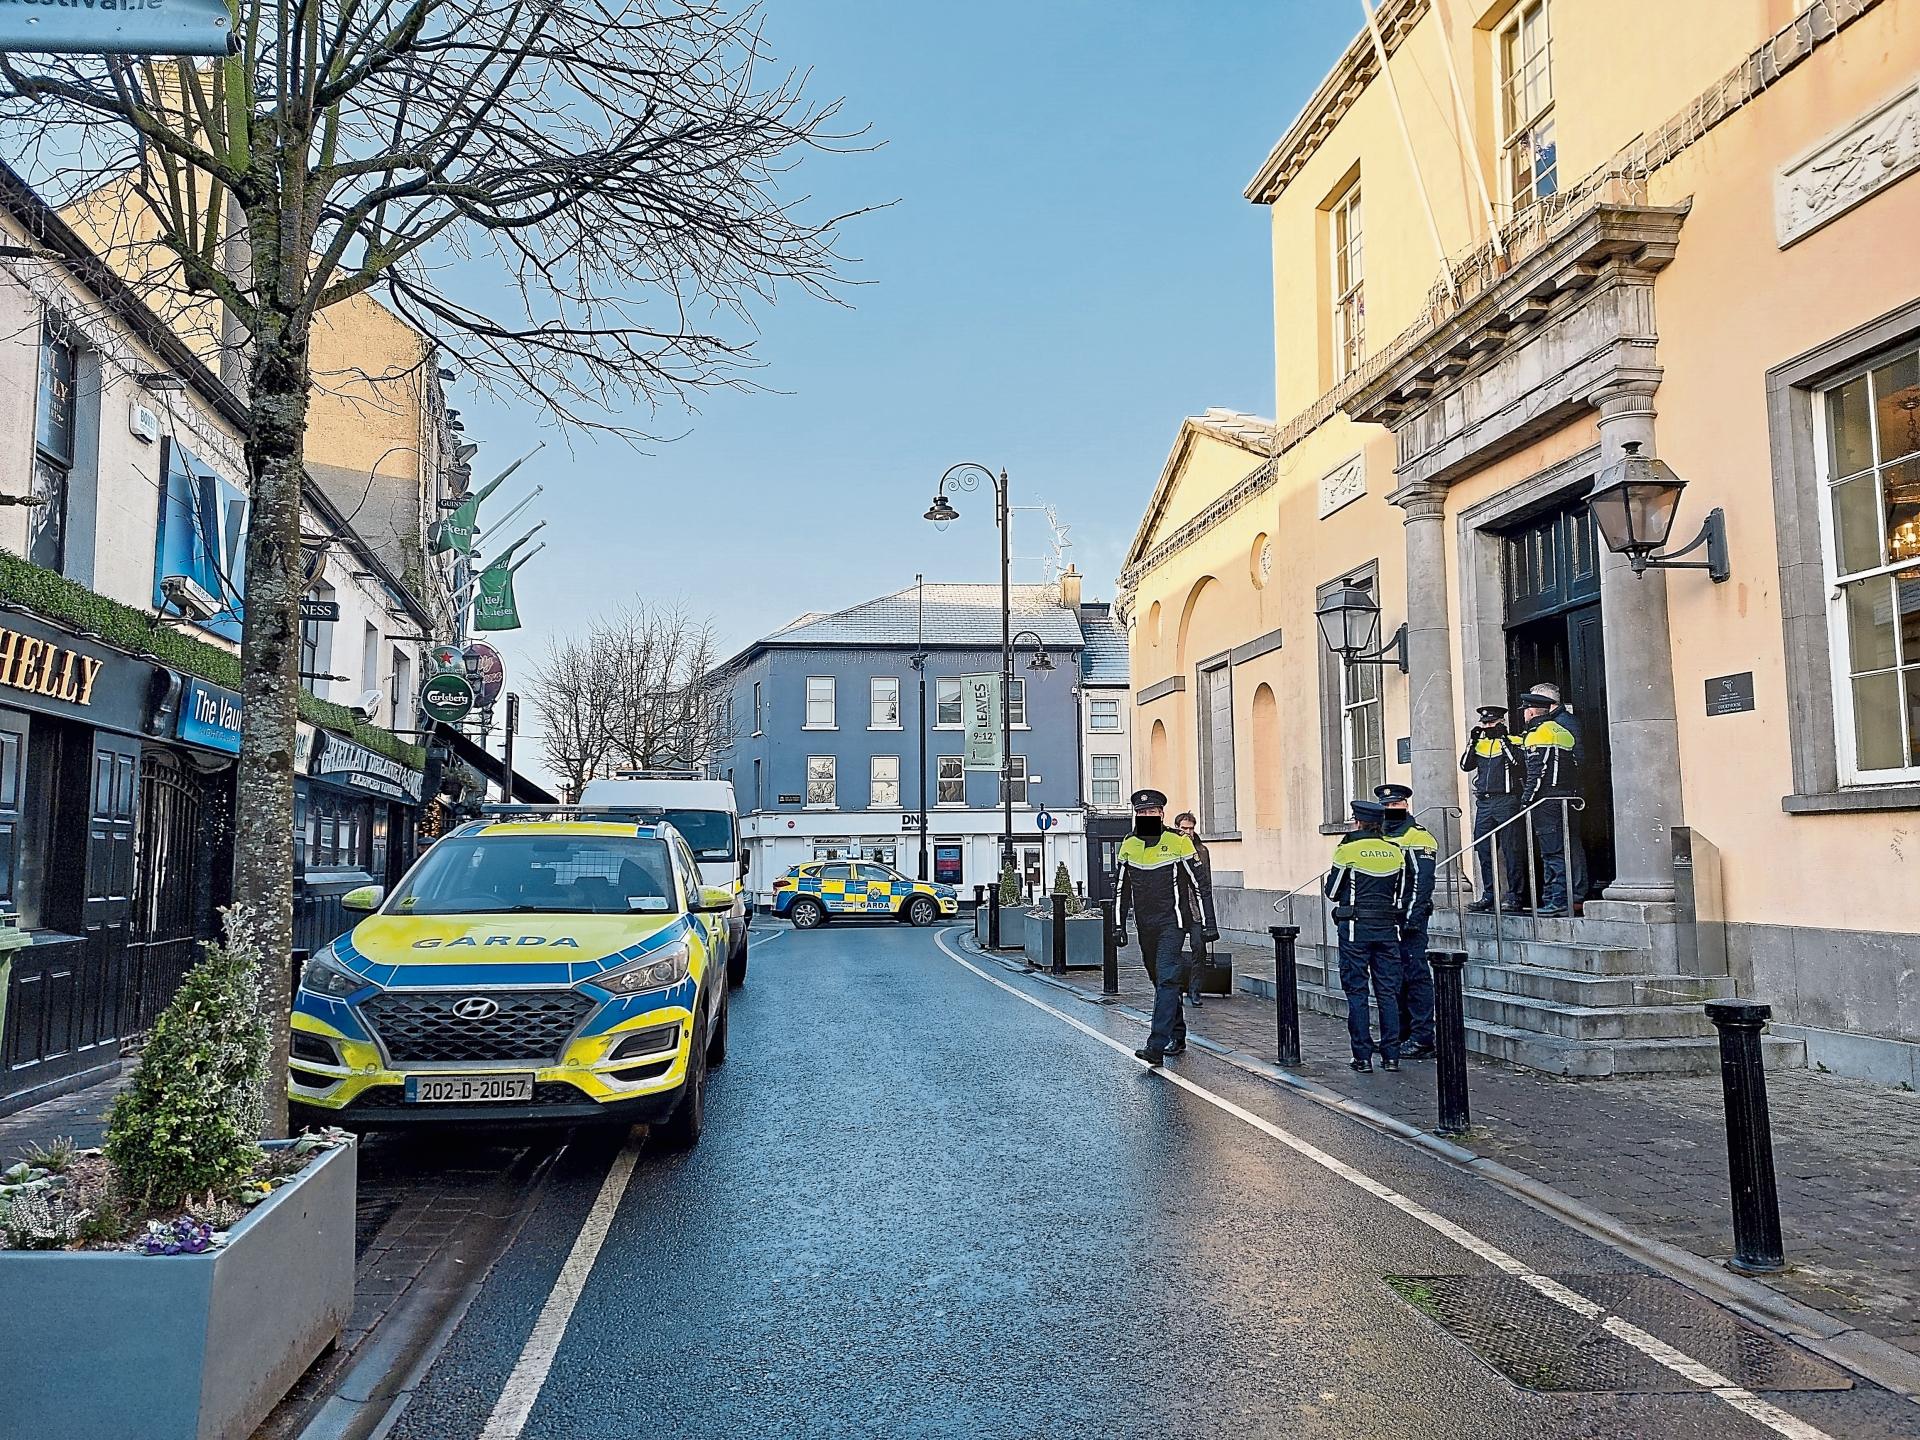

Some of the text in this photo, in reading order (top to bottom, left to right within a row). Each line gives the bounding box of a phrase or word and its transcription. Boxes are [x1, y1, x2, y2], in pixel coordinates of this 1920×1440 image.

[299, 604, 332, 616] NESS
[427, 690, 469, 706] Carlsberg
[195, 689, 217, 725] The
[974, 683, 989, 728] LEAVES
[902, 814, 929, 826] DN
[1360, 850, 1395, 859] GARDA
[859, 902, 890, 910] GARDA
[411, 935, 580, 949] GARDA
[422, 1079, 527, 1101] 202-D-20157
